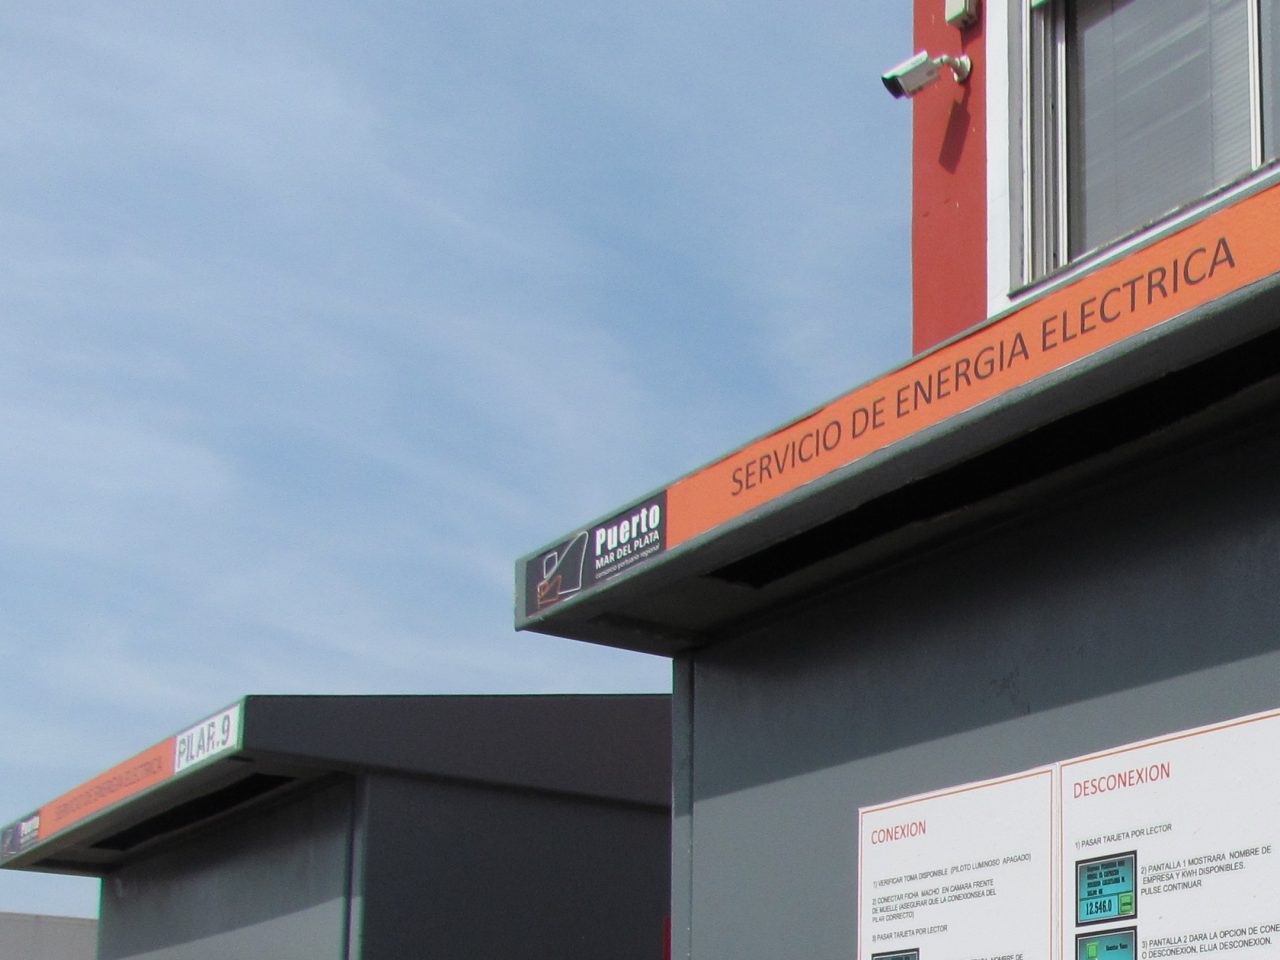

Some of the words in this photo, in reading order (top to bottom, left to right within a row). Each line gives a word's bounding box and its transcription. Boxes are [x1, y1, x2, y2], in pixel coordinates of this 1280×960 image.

[730, 418, 840, 496] SERVICIO
[852, 398, 886, 440] DE
[896, 332, 1028, 421] ENERGIA
[1042, 236, 1236, 355] ELECTRICA
[595, 505, 660, 556] Puerto
[595, 552, 615, 570] MAR
[617, 544, 632, 560] DEL
[634, 530, 660, 551] PLATA
[1073, 762, 1171, 799] DESCONEXION
[871, 820, 926, 844] CONEXION
[1081, 837, 1101, 848] PASAR
[1103, 832, 1129, 844] TARJETA
[1130, 829, 1144, 839] POR
[1145, 824, 1172, 837] LECTOR
[1148, 860, 1181, 873] PANTALLA
[1188, 853, 1226, 867] MOSTRARA
[1229, 848, 1259, 861] NOMBRE
[1141, 885, 1161, 895] PULSE
[1163, 880, 1201, 892] CONTINUAR
[1143, 872, 1174, 884] EMPRESA
[1182, 869, 1197, 879] KWH
[1149, 936, 1182, 948] PANTALLA
[1188, 933, 1207, 943] DARA
[1219, 928, 1246, 939] OPCION
[1199, 943, 1217, 953] ELIJA
